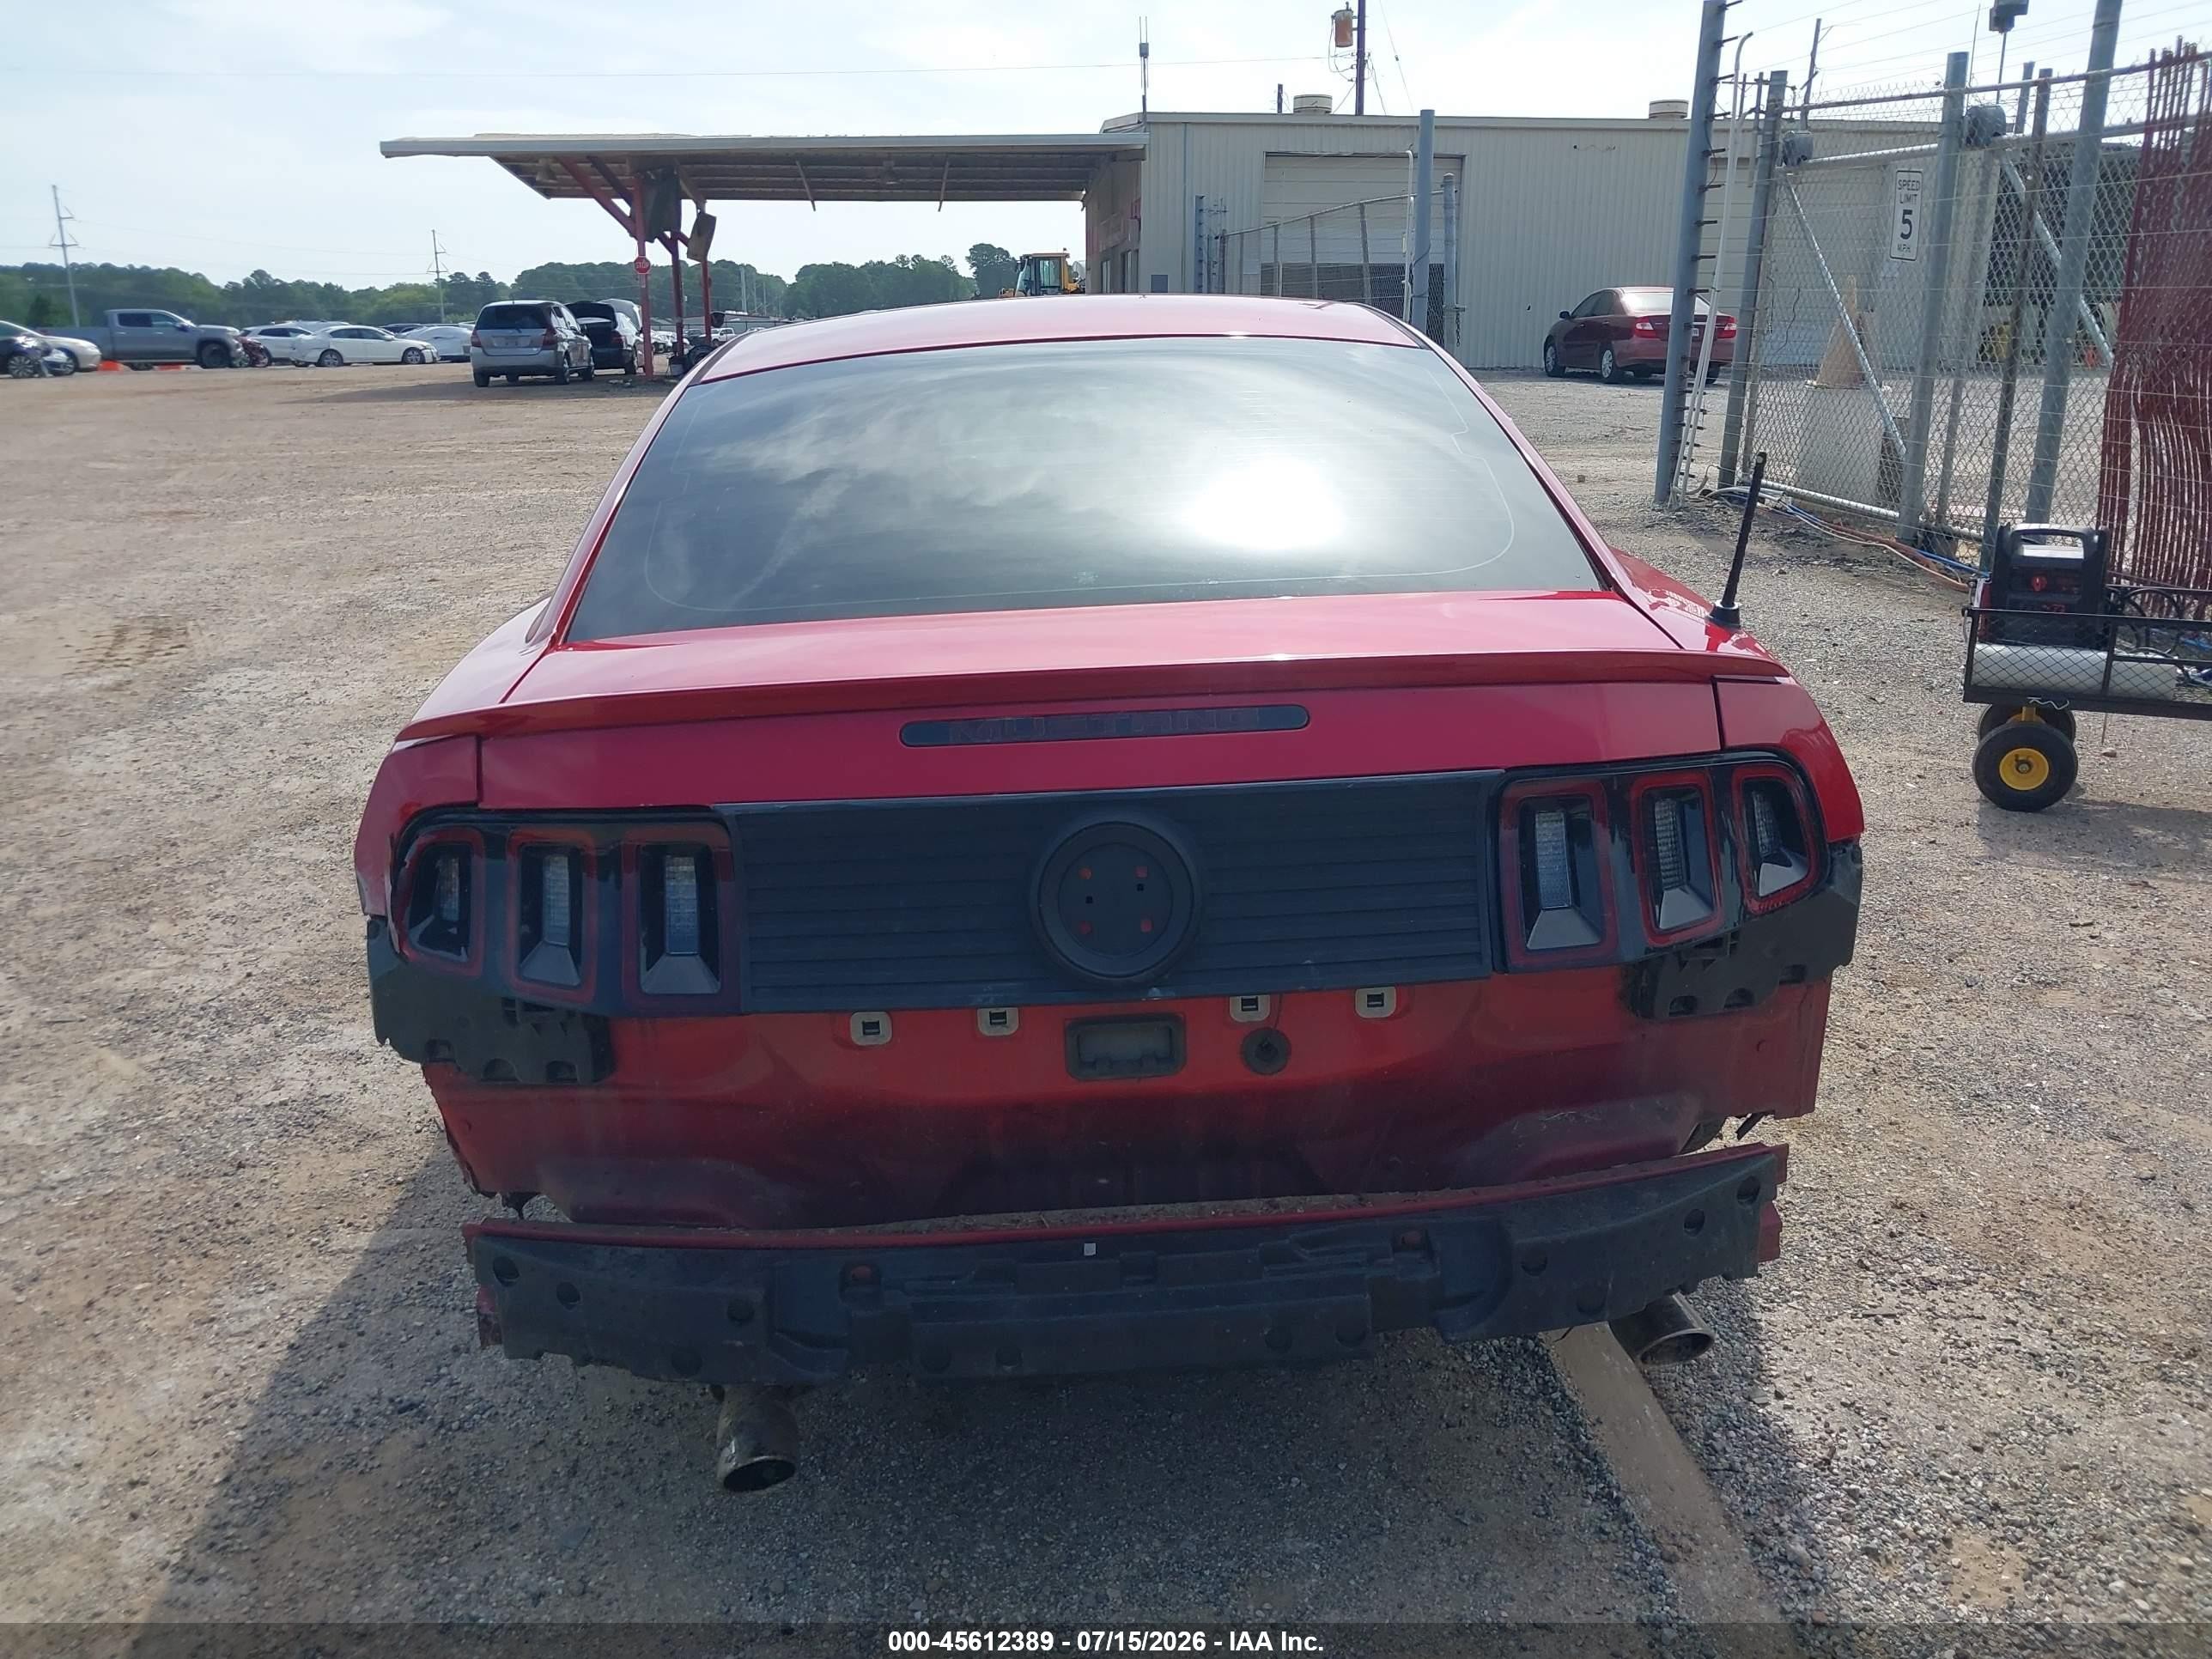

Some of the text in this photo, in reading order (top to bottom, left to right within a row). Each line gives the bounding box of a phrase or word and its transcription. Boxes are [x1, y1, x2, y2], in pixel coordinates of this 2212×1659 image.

[1898, 179, 1921, 191] SPEED
[1899, 193, 1917, 204] LIMIT
[1900, 209, 1913, 240] 5
